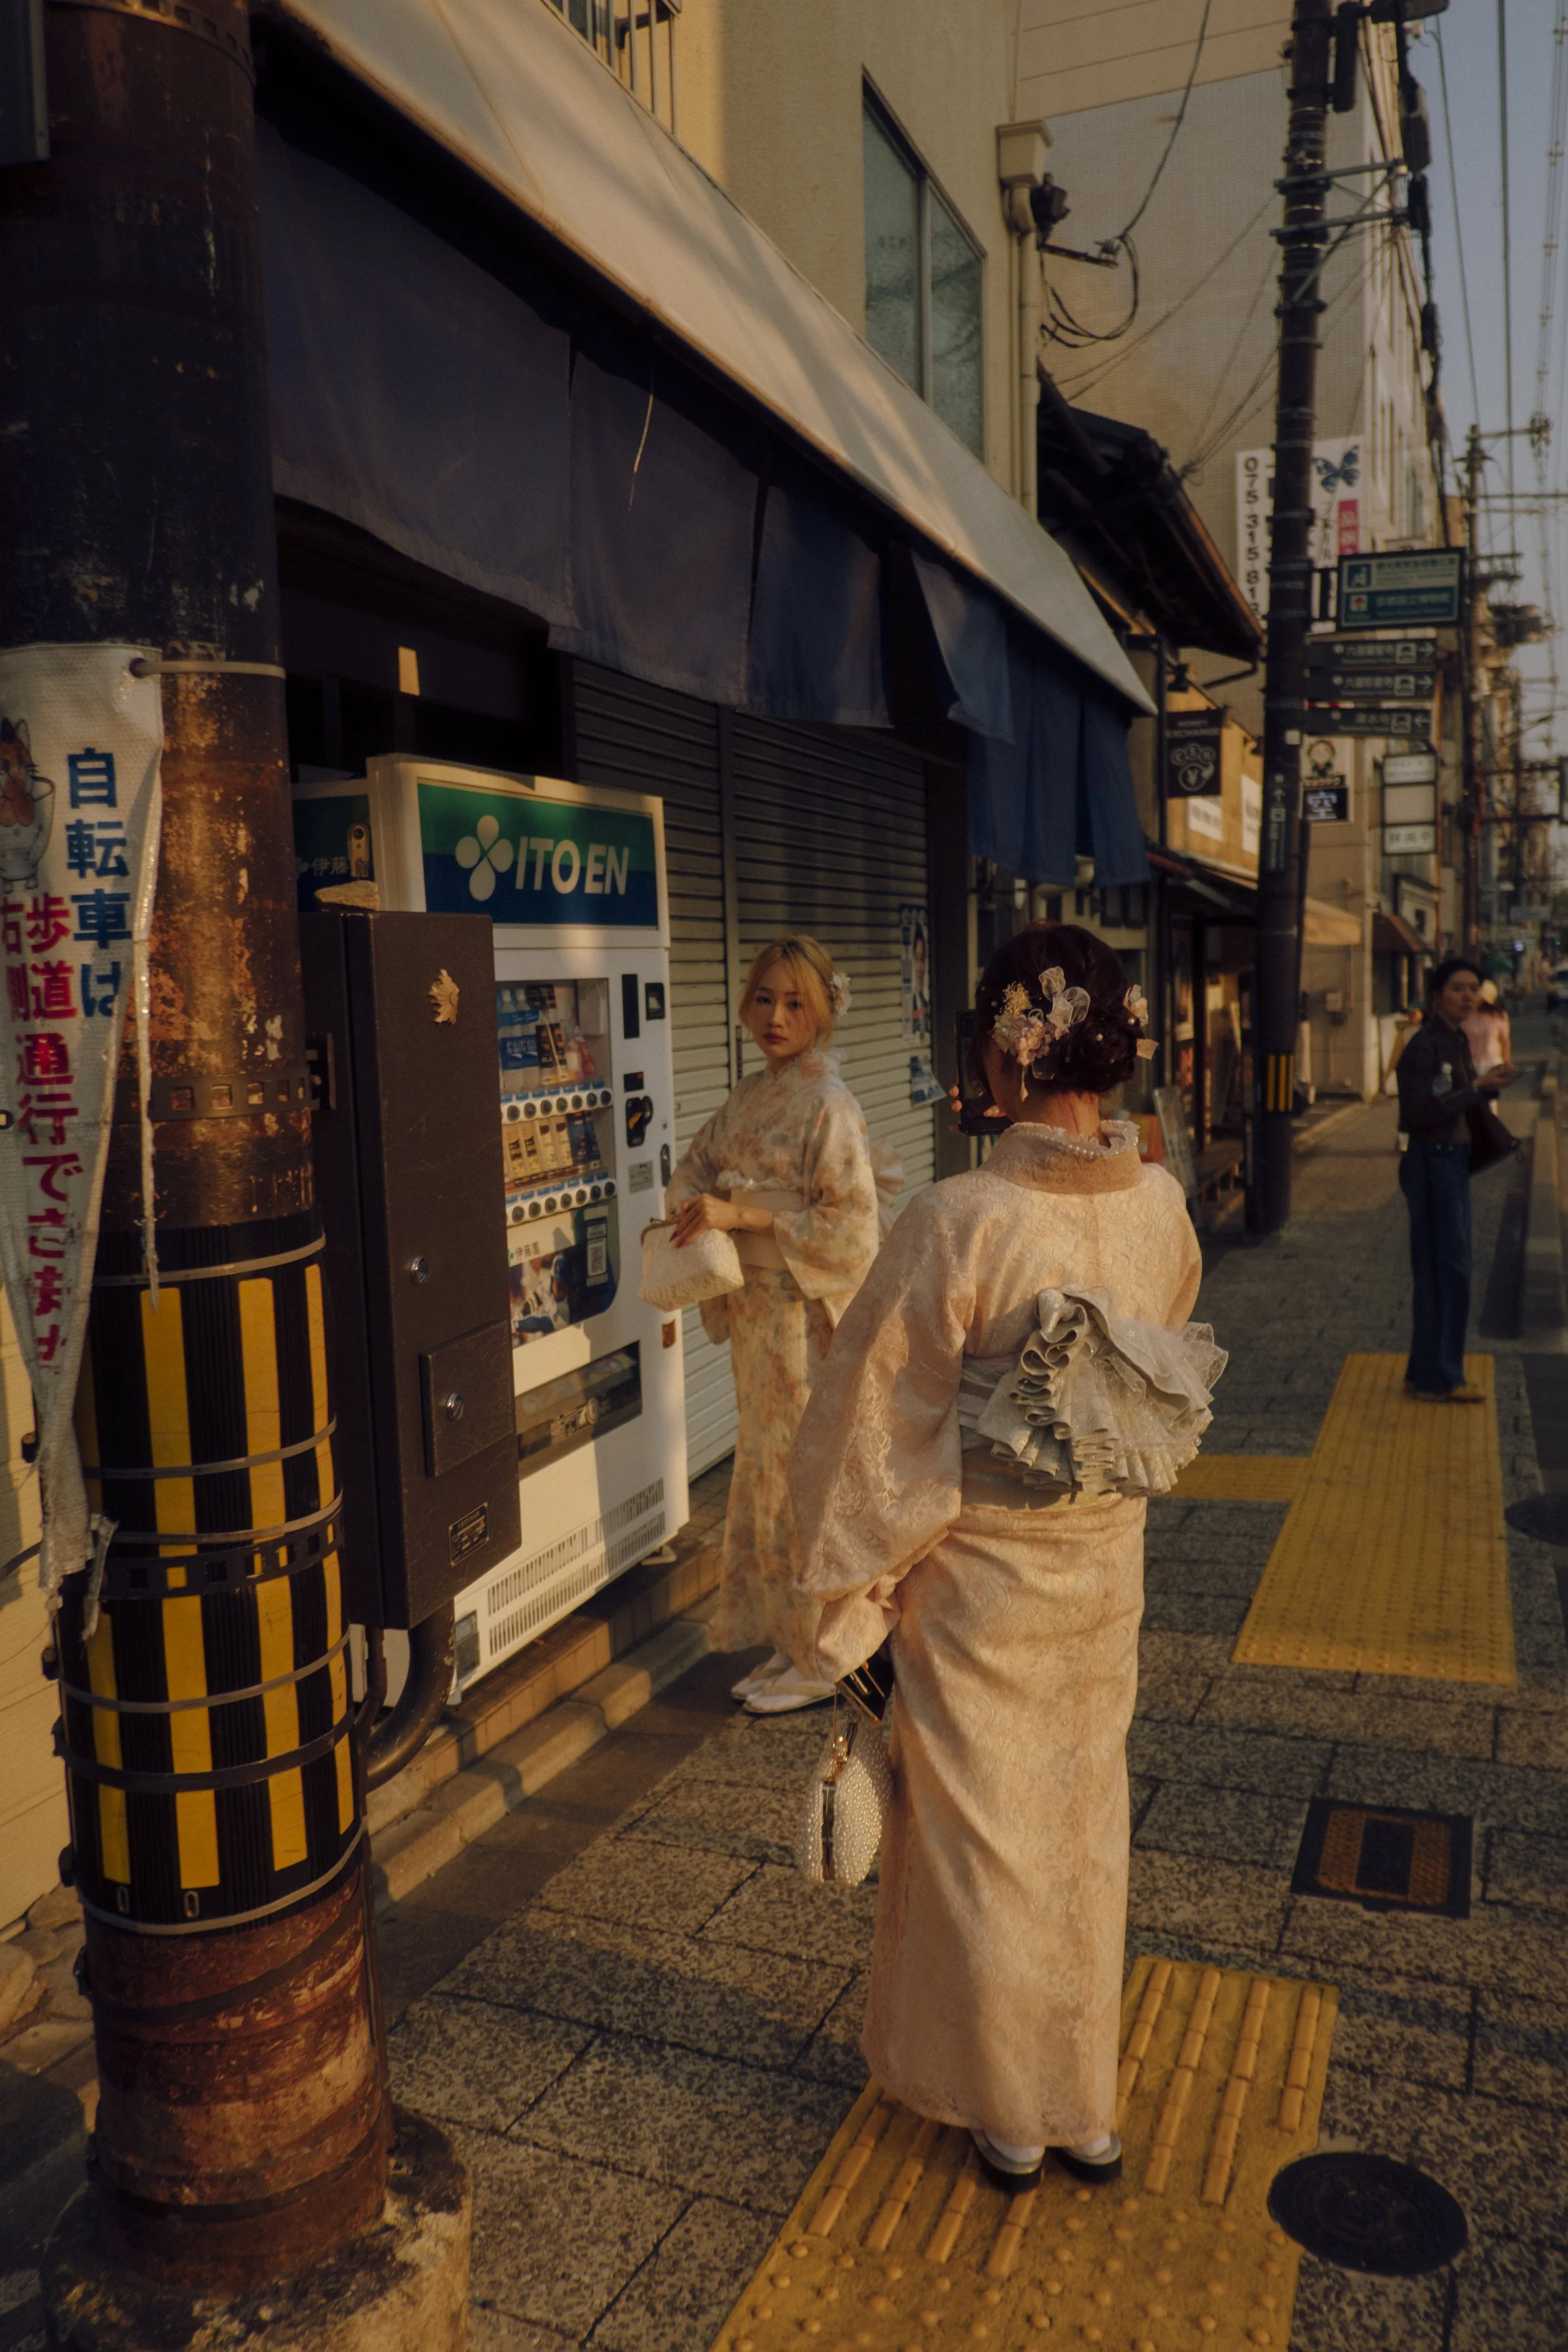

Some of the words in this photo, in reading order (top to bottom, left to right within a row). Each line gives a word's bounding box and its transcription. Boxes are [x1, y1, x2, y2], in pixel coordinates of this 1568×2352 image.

[65, 747, 132, 1017] 自転車は
[515, 836, 581, 894] ITO
[584, 843, 629, 896] EN
[516, 1241, 540, 1261] 伊藤園
